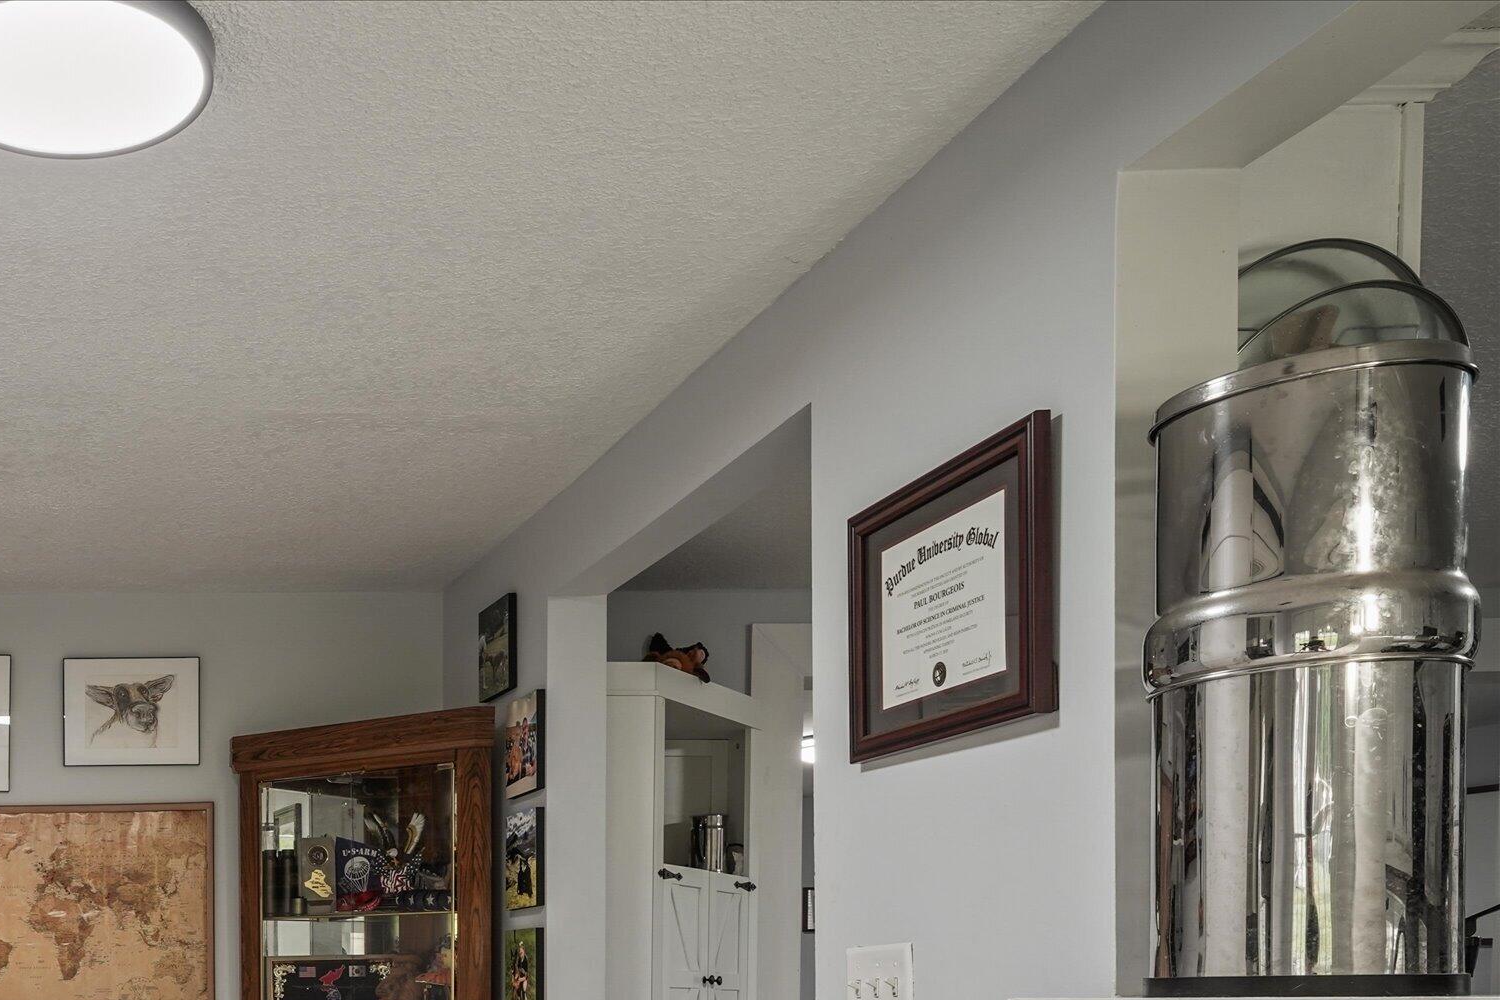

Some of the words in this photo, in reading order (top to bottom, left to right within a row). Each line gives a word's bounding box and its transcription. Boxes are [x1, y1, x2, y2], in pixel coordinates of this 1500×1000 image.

[884, 558, 916, 597] Purdue
[917, 531, 964, 565] University
[965, 526, 1000, 549] Global
[913, 598, 927, 610] PAUL
[928, 581, 965, 605] BOURGEOIS
[966, 594, 986, 608] JUSTICE
